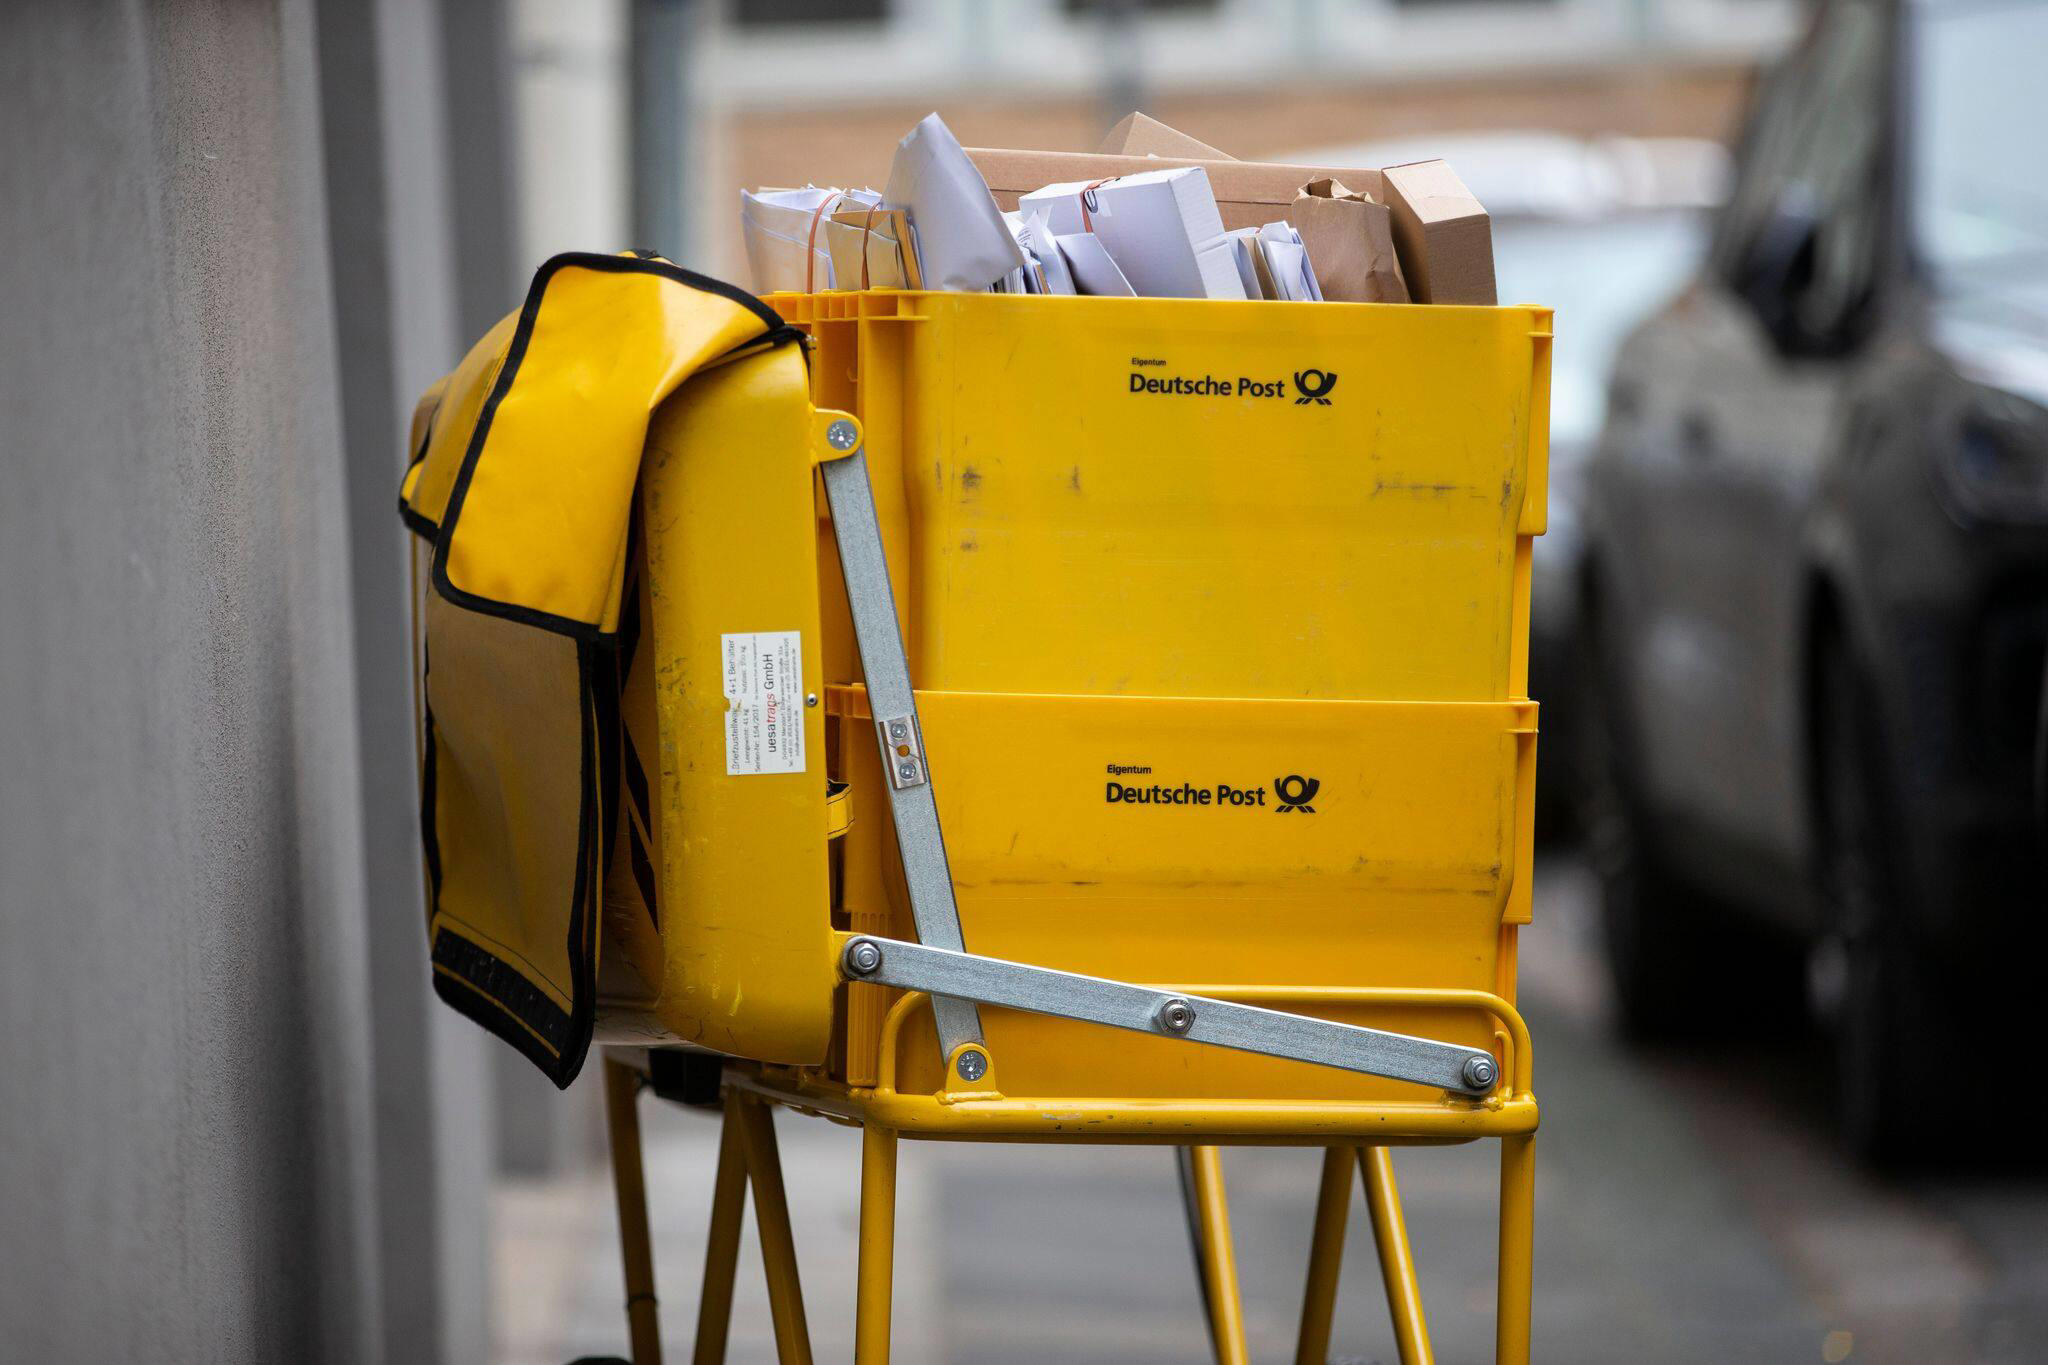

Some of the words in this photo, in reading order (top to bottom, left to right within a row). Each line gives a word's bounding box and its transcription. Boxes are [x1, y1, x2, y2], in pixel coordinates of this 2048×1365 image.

[1131, 357, 1167, 367] Eigentum
[1129, 373, 1232, 396] Deutsche
[1238, 376, 1285, 398] Post
[763, 654, 775, 690] GmbH
[1107, 764, 1152, 776] Eigentum
[1106, 782, 1212, 806] Deutsche
[1217, 784, 1266, 807] Post
